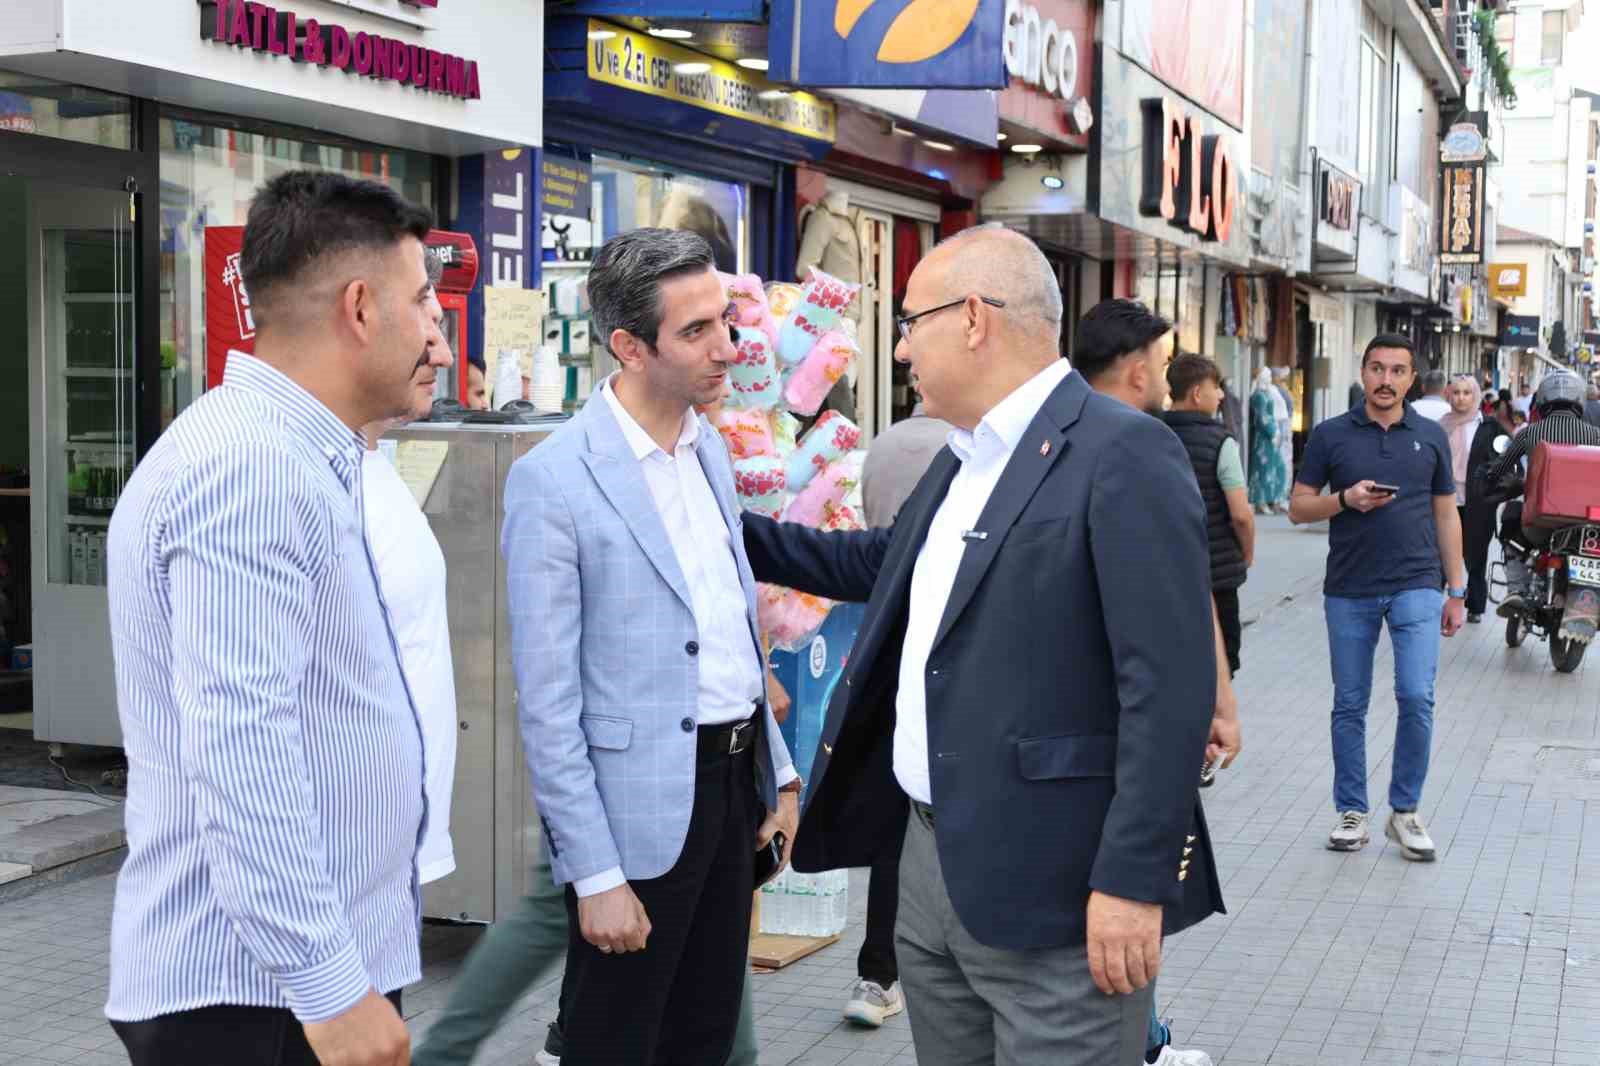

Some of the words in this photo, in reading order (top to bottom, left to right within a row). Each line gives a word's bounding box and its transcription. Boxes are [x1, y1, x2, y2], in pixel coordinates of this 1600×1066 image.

[213, 0, 297, 58] TATLI
[302, 18, 327, 66] &
[332, 24, 481, 100] DONDURMA
[608, 53, 619, 75] ve
[651, 57, 670, 89] CEP
[1142, 97, 1234, 243] FLO
